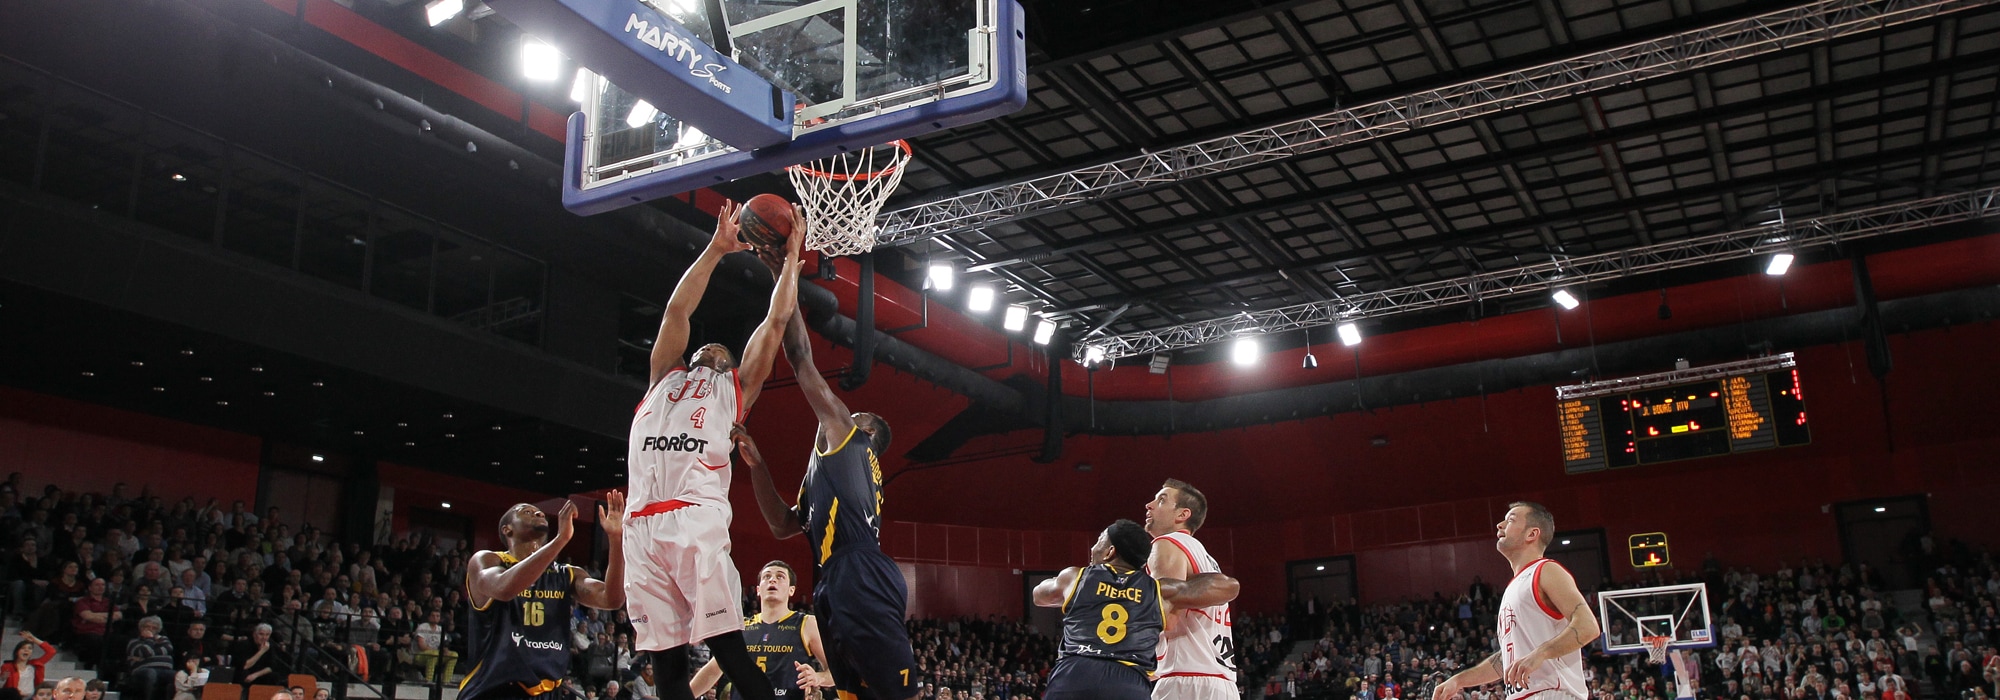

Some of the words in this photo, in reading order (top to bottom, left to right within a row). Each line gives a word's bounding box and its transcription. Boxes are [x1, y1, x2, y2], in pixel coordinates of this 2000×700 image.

[625, 13, 702, 69] MARTY
[690, 406, 707, 429] 4
[535, 590, 565, 599] TOULON
[1096, 581, 1143, 603] PIERCE
[522, 601, 545, 627] 16
[1096, 603, 1129, 645] 8
[524, 638, 563, 651] transdev
[763, 645, 794, 653] TOULON
[899, 668, 910, 687] 7
